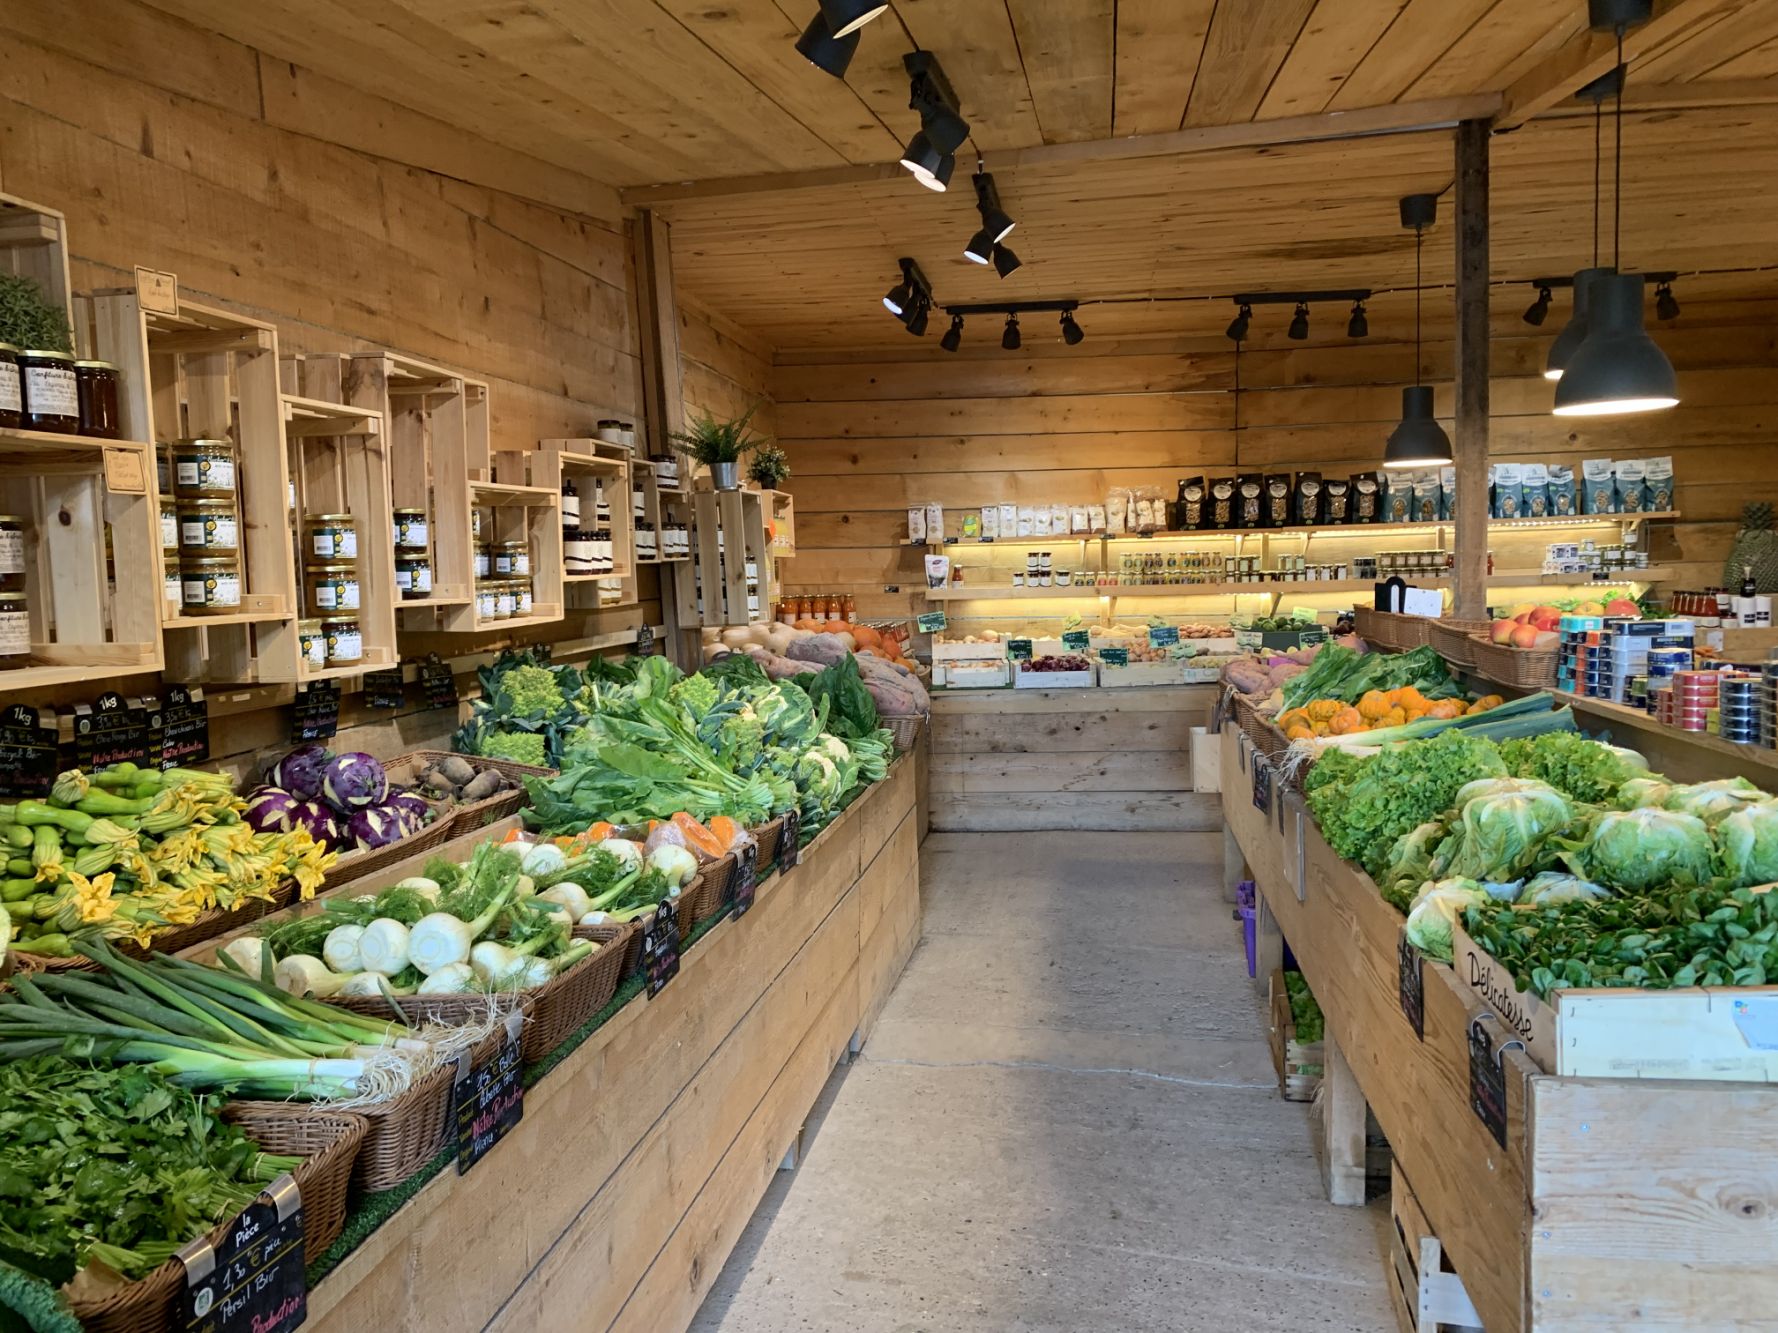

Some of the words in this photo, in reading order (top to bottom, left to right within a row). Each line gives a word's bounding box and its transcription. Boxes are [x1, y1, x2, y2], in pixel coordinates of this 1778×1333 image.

[100, 696, 117, 710] 1kg
[170, 690, 184, 703] 1kg
[14, 706, 32, 726] 1kg
[1467, 951, 1534, 1042] Délicatesse
[242, 1213, 251, 1228] la
[219, 1283, 251, 1325] Persil
[254, 1265, 280, 1293] Bio
